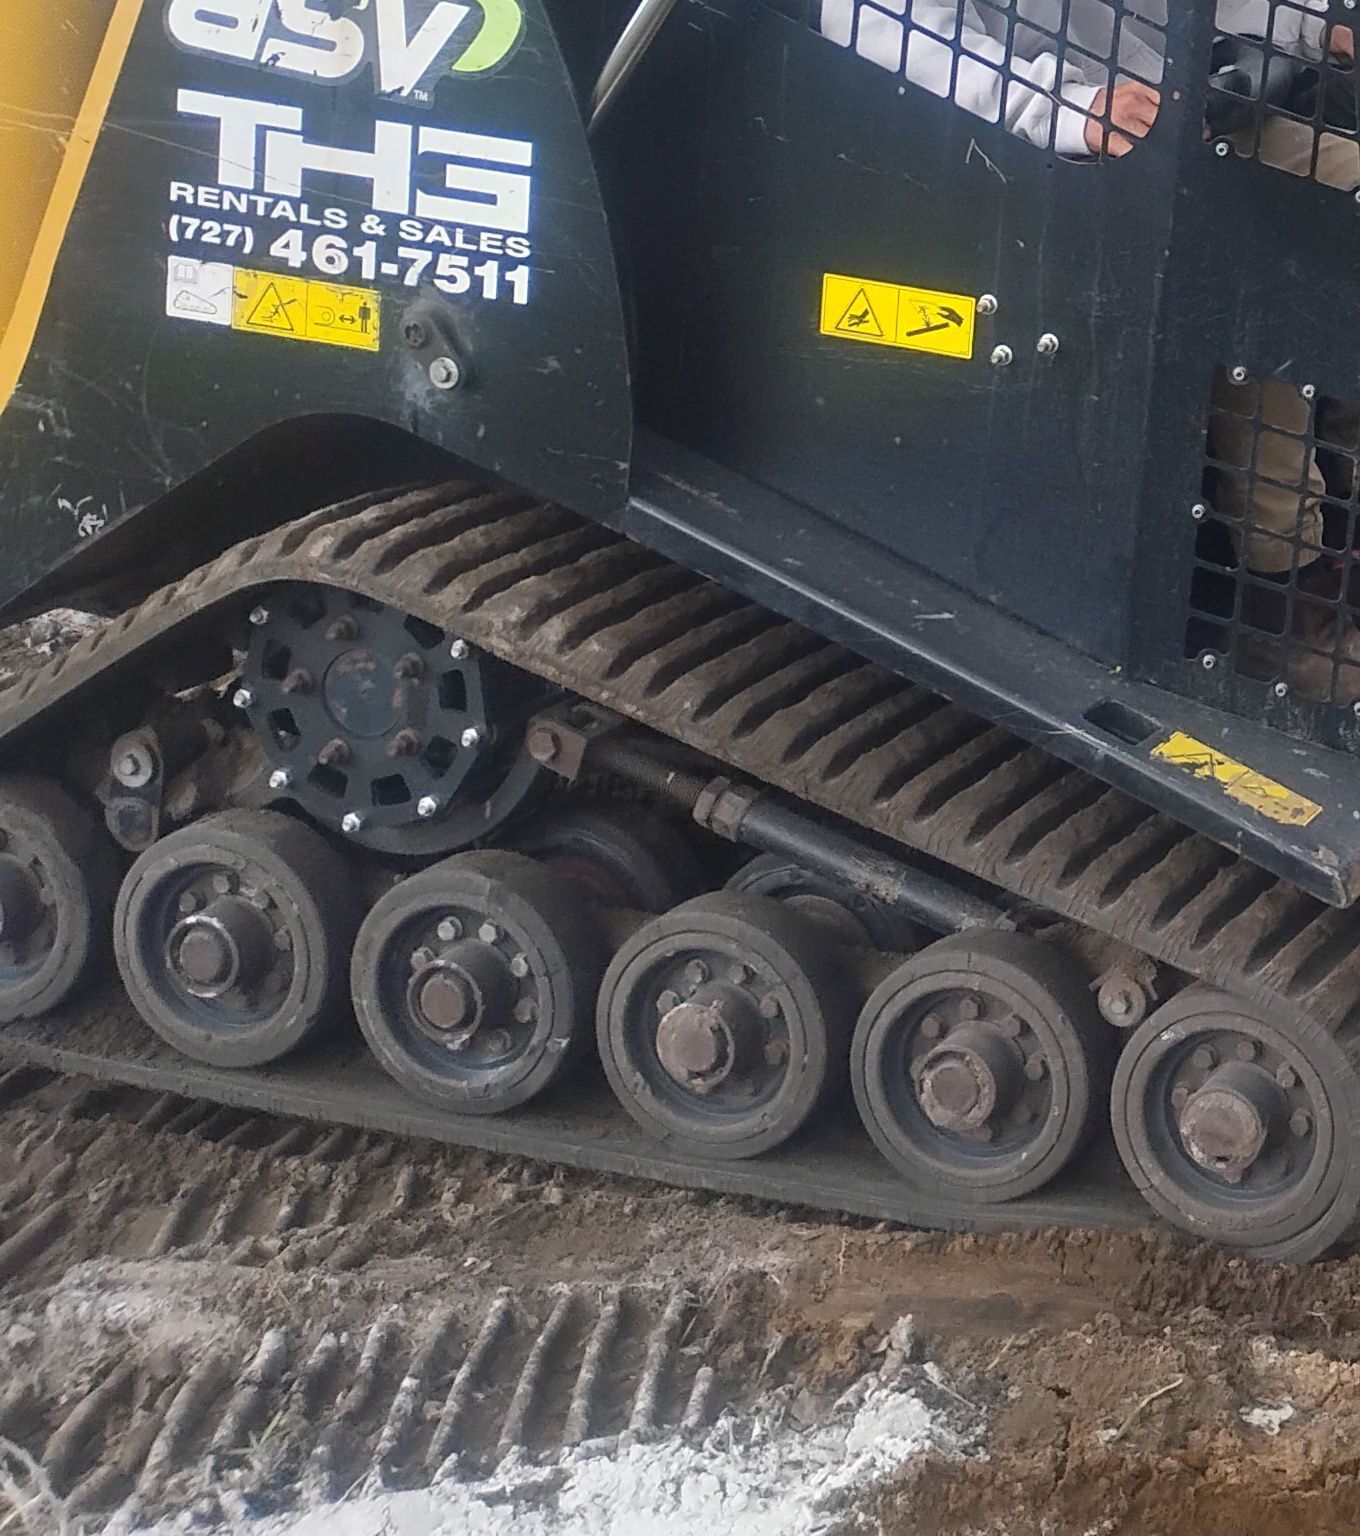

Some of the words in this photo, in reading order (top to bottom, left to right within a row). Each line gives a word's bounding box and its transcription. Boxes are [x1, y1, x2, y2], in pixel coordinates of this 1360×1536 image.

[168, 214, 254, 254] (727)
[269, 229, 530, 305] 461-7511
[169, 181, 348, 229] RENTALS
[360, 213, 387, 236] &
[399, 220, 531, 258] SALES
